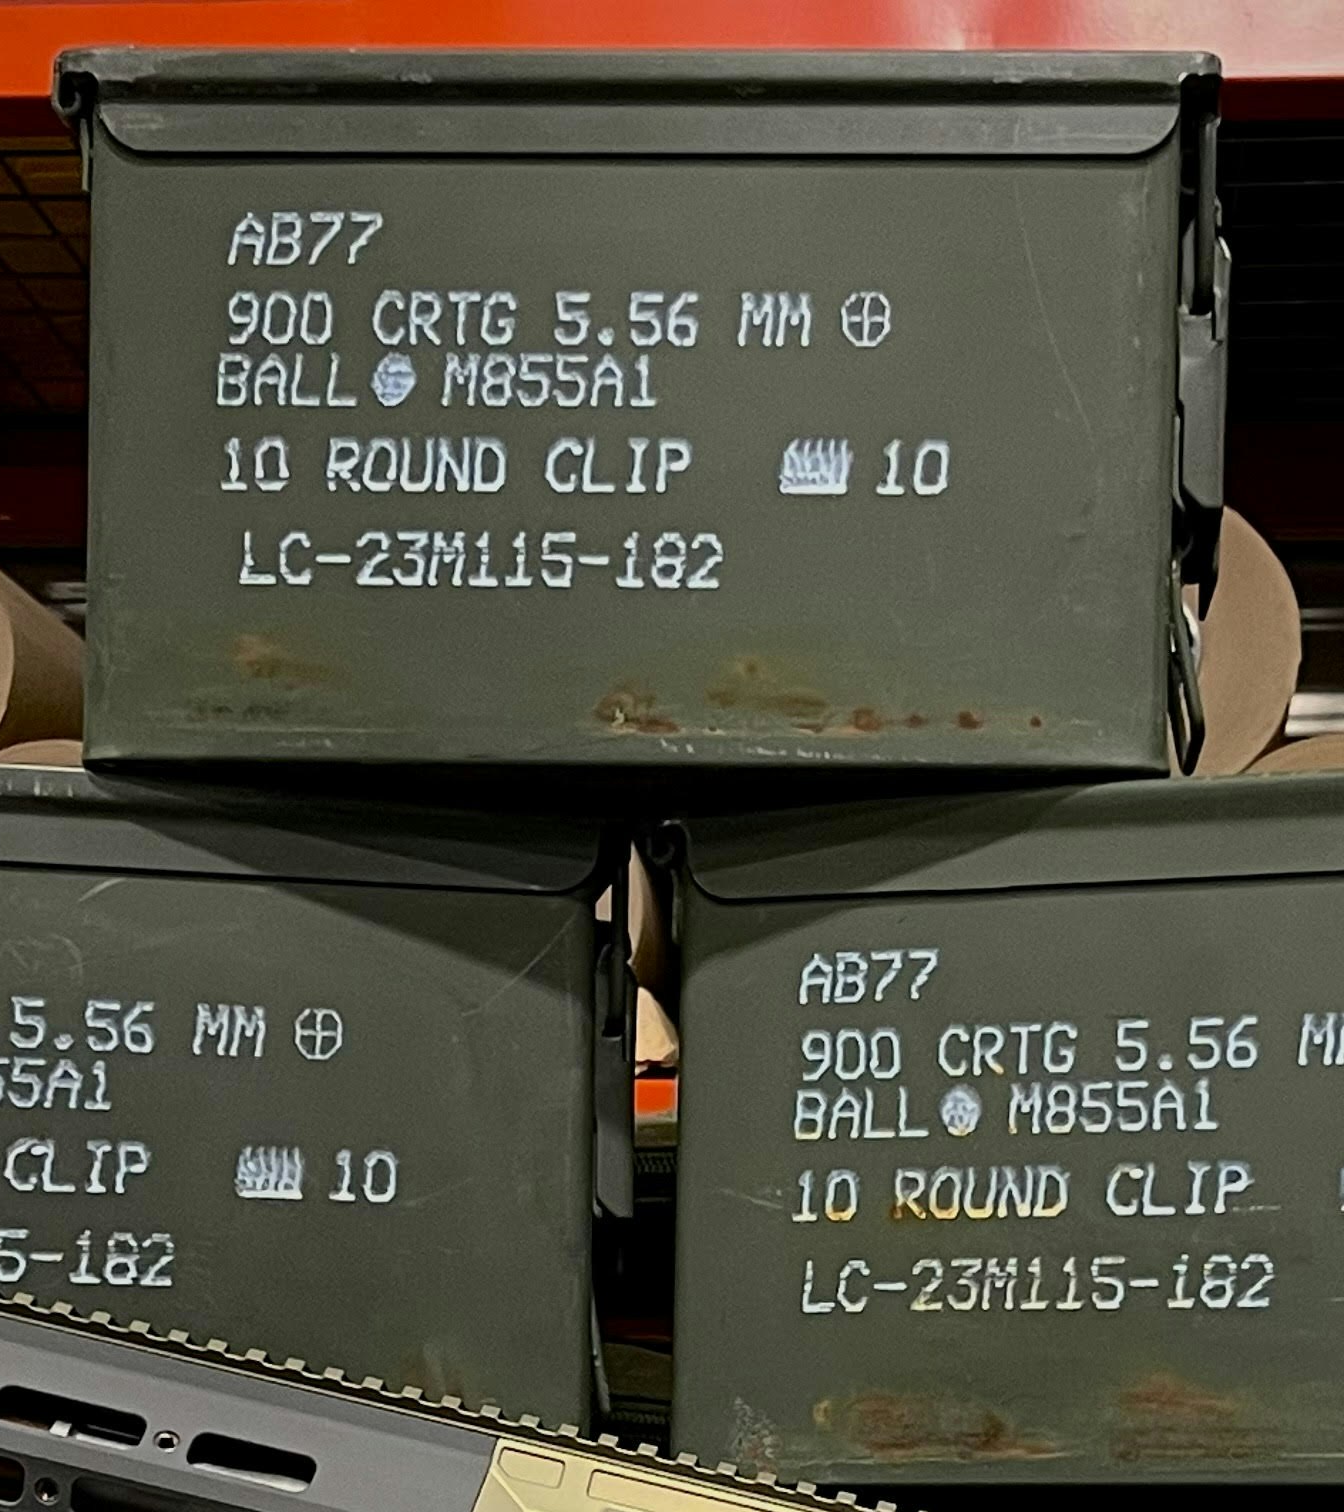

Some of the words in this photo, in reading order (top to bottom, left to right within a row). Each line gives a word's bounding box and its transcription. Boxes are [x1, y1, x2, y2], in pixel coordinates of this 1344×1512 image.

[227, 211, 384, 266] AB77
[228, 291, 333, 345] 900
[372, 289, 518, 346] CRTG
[554, 291, 699, 347] 5.56
[737, 292, 812, 347] MM
[216, 352, 357, 407] BALL
[441, 352, 657, 407] M855A1
[220, 437, 290, 491] 10
[326, 437, 506, 493] ROUND
[544, 438, 692, 493] CLIP
[875, 439, 950, 495] 10
[239, 530, 724, 589] LC-23M115-182
[799, 948, 938, 1005] AB77
[9, 996, 155, 1054] 5.56
[192, 1003, 266, 1058] MM
[801, 1028, 901, 1081] 900
[938, 1021, 1078, 1076] CRTG
[1115, 1015, 1258, 1071] 5.56
[793, 1086, 930, 1140] BALL
[1008, 1078, 1219, 1135] M855A1
[3, 1138, 151, 1194] CLIP
[328, 1149, 397, 1203] 10
[791, 1170, 858, 1222] 10
[894, 1165, 1070, 1219] ROUND
[1106, 1162, 1253, 1216] CLIP
[802, 1253, 1275, 1313] LC-23M115-182
